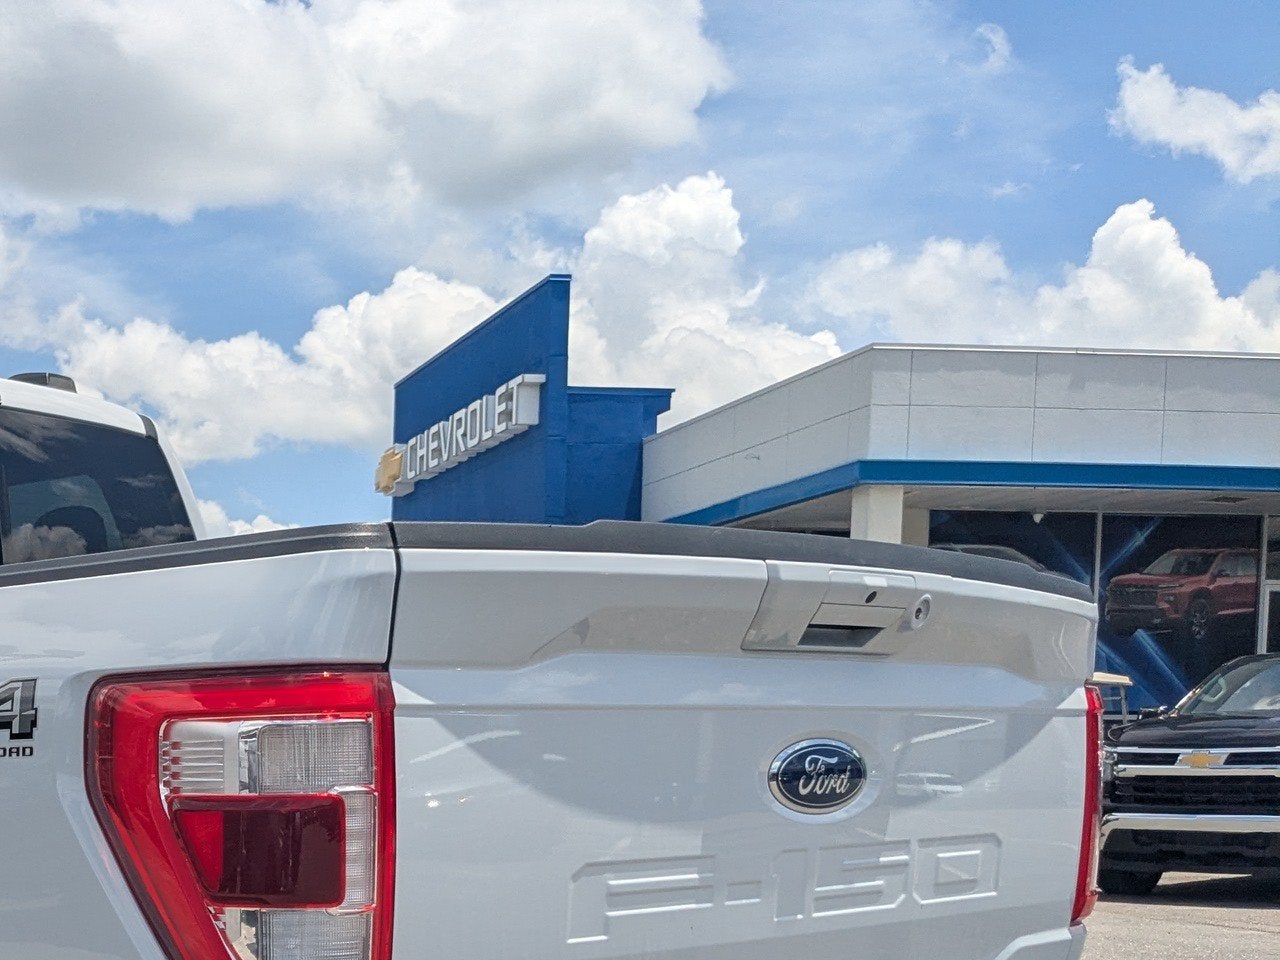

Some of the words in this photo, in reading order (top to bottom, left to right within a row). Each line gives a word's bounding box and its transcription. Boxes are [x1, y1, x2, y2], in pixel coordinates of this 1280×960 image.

[405, 373, 546, 480] CHEVROLET
[798, 754, 851, 796] Ford
[567, 832, 1001, 943] F-150
